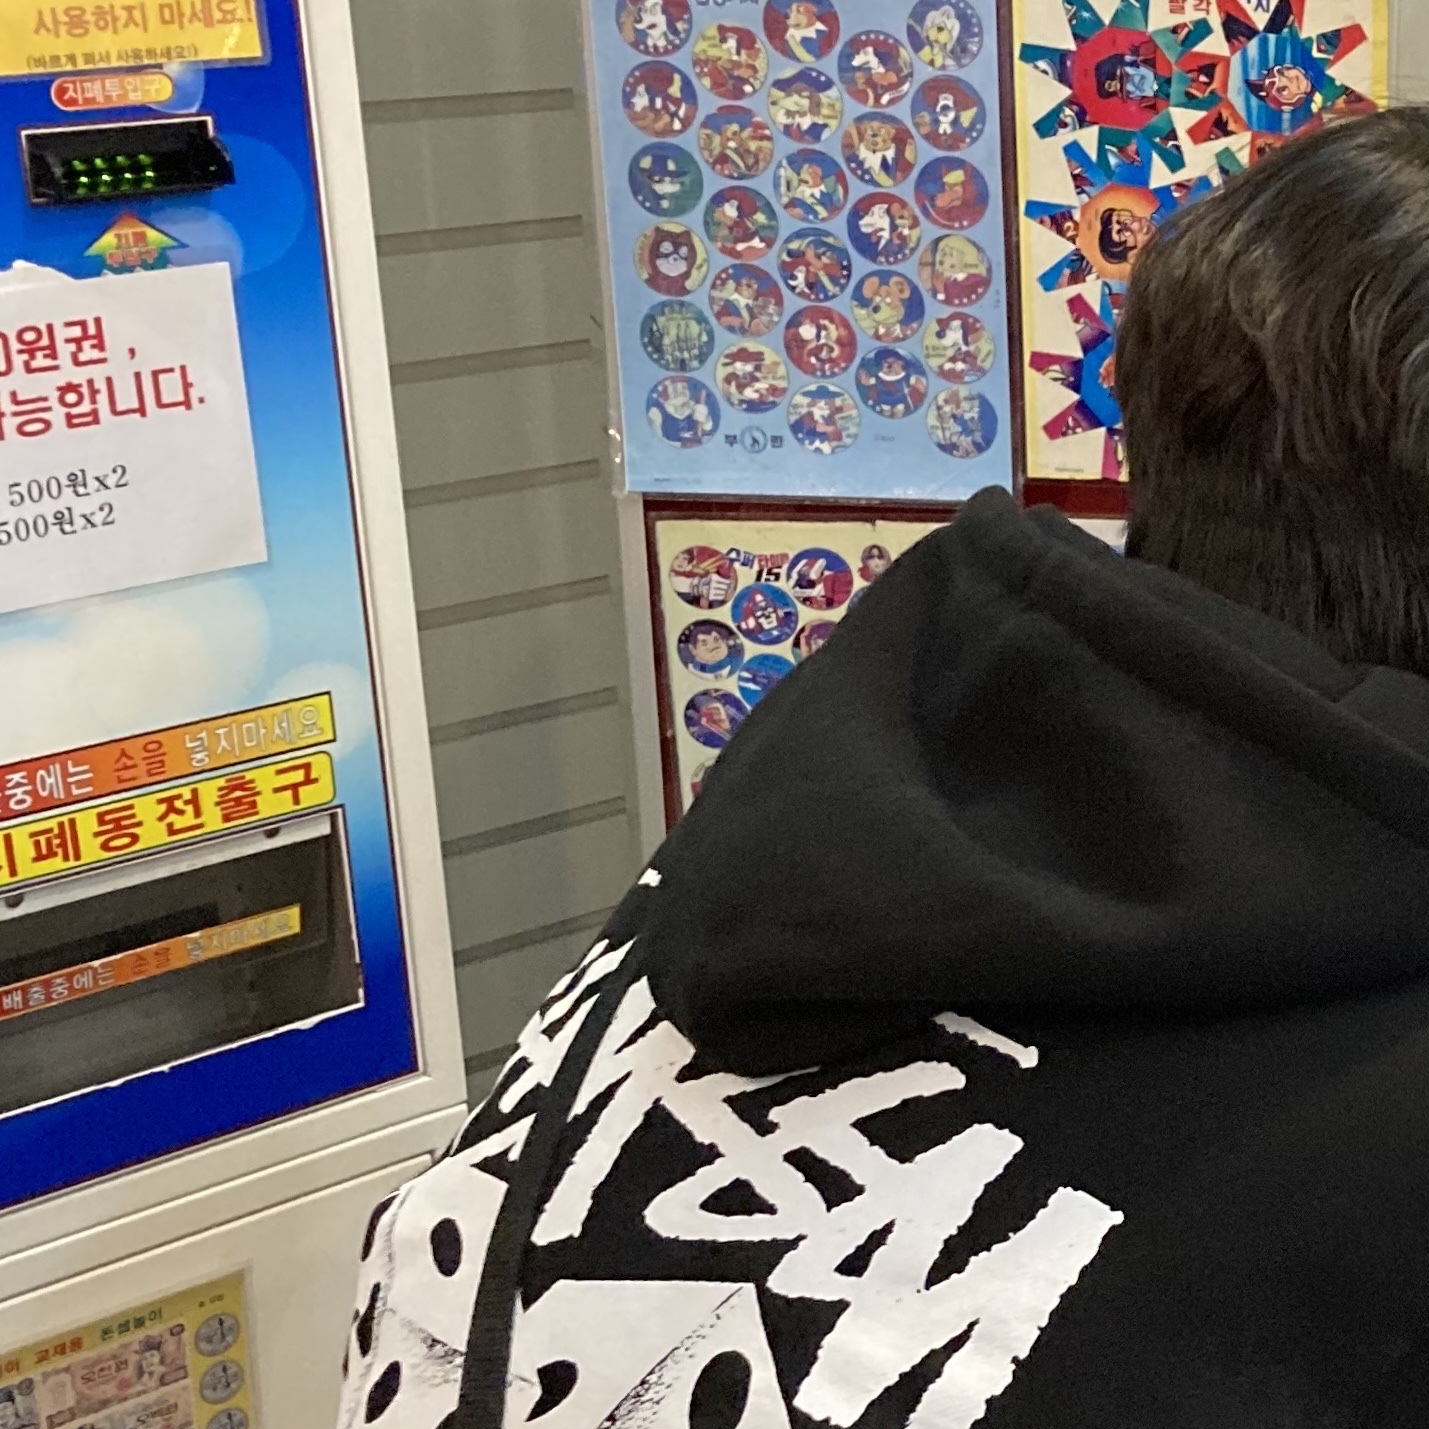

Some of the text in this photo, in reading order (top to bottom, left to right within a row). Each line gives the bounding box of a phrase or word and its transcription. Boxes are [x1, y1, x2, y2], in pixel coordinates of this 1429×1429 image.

[34, 4, 149, 38] 사용하지
[63, 77, 162, 105] 지폐투입구
[0, 364, 205, 441] 능합니다.
[8, 464, 129, 507] 500원x2
[0, 757, 94, 813] 중에는
[112, 739, 168, 785] 손을
